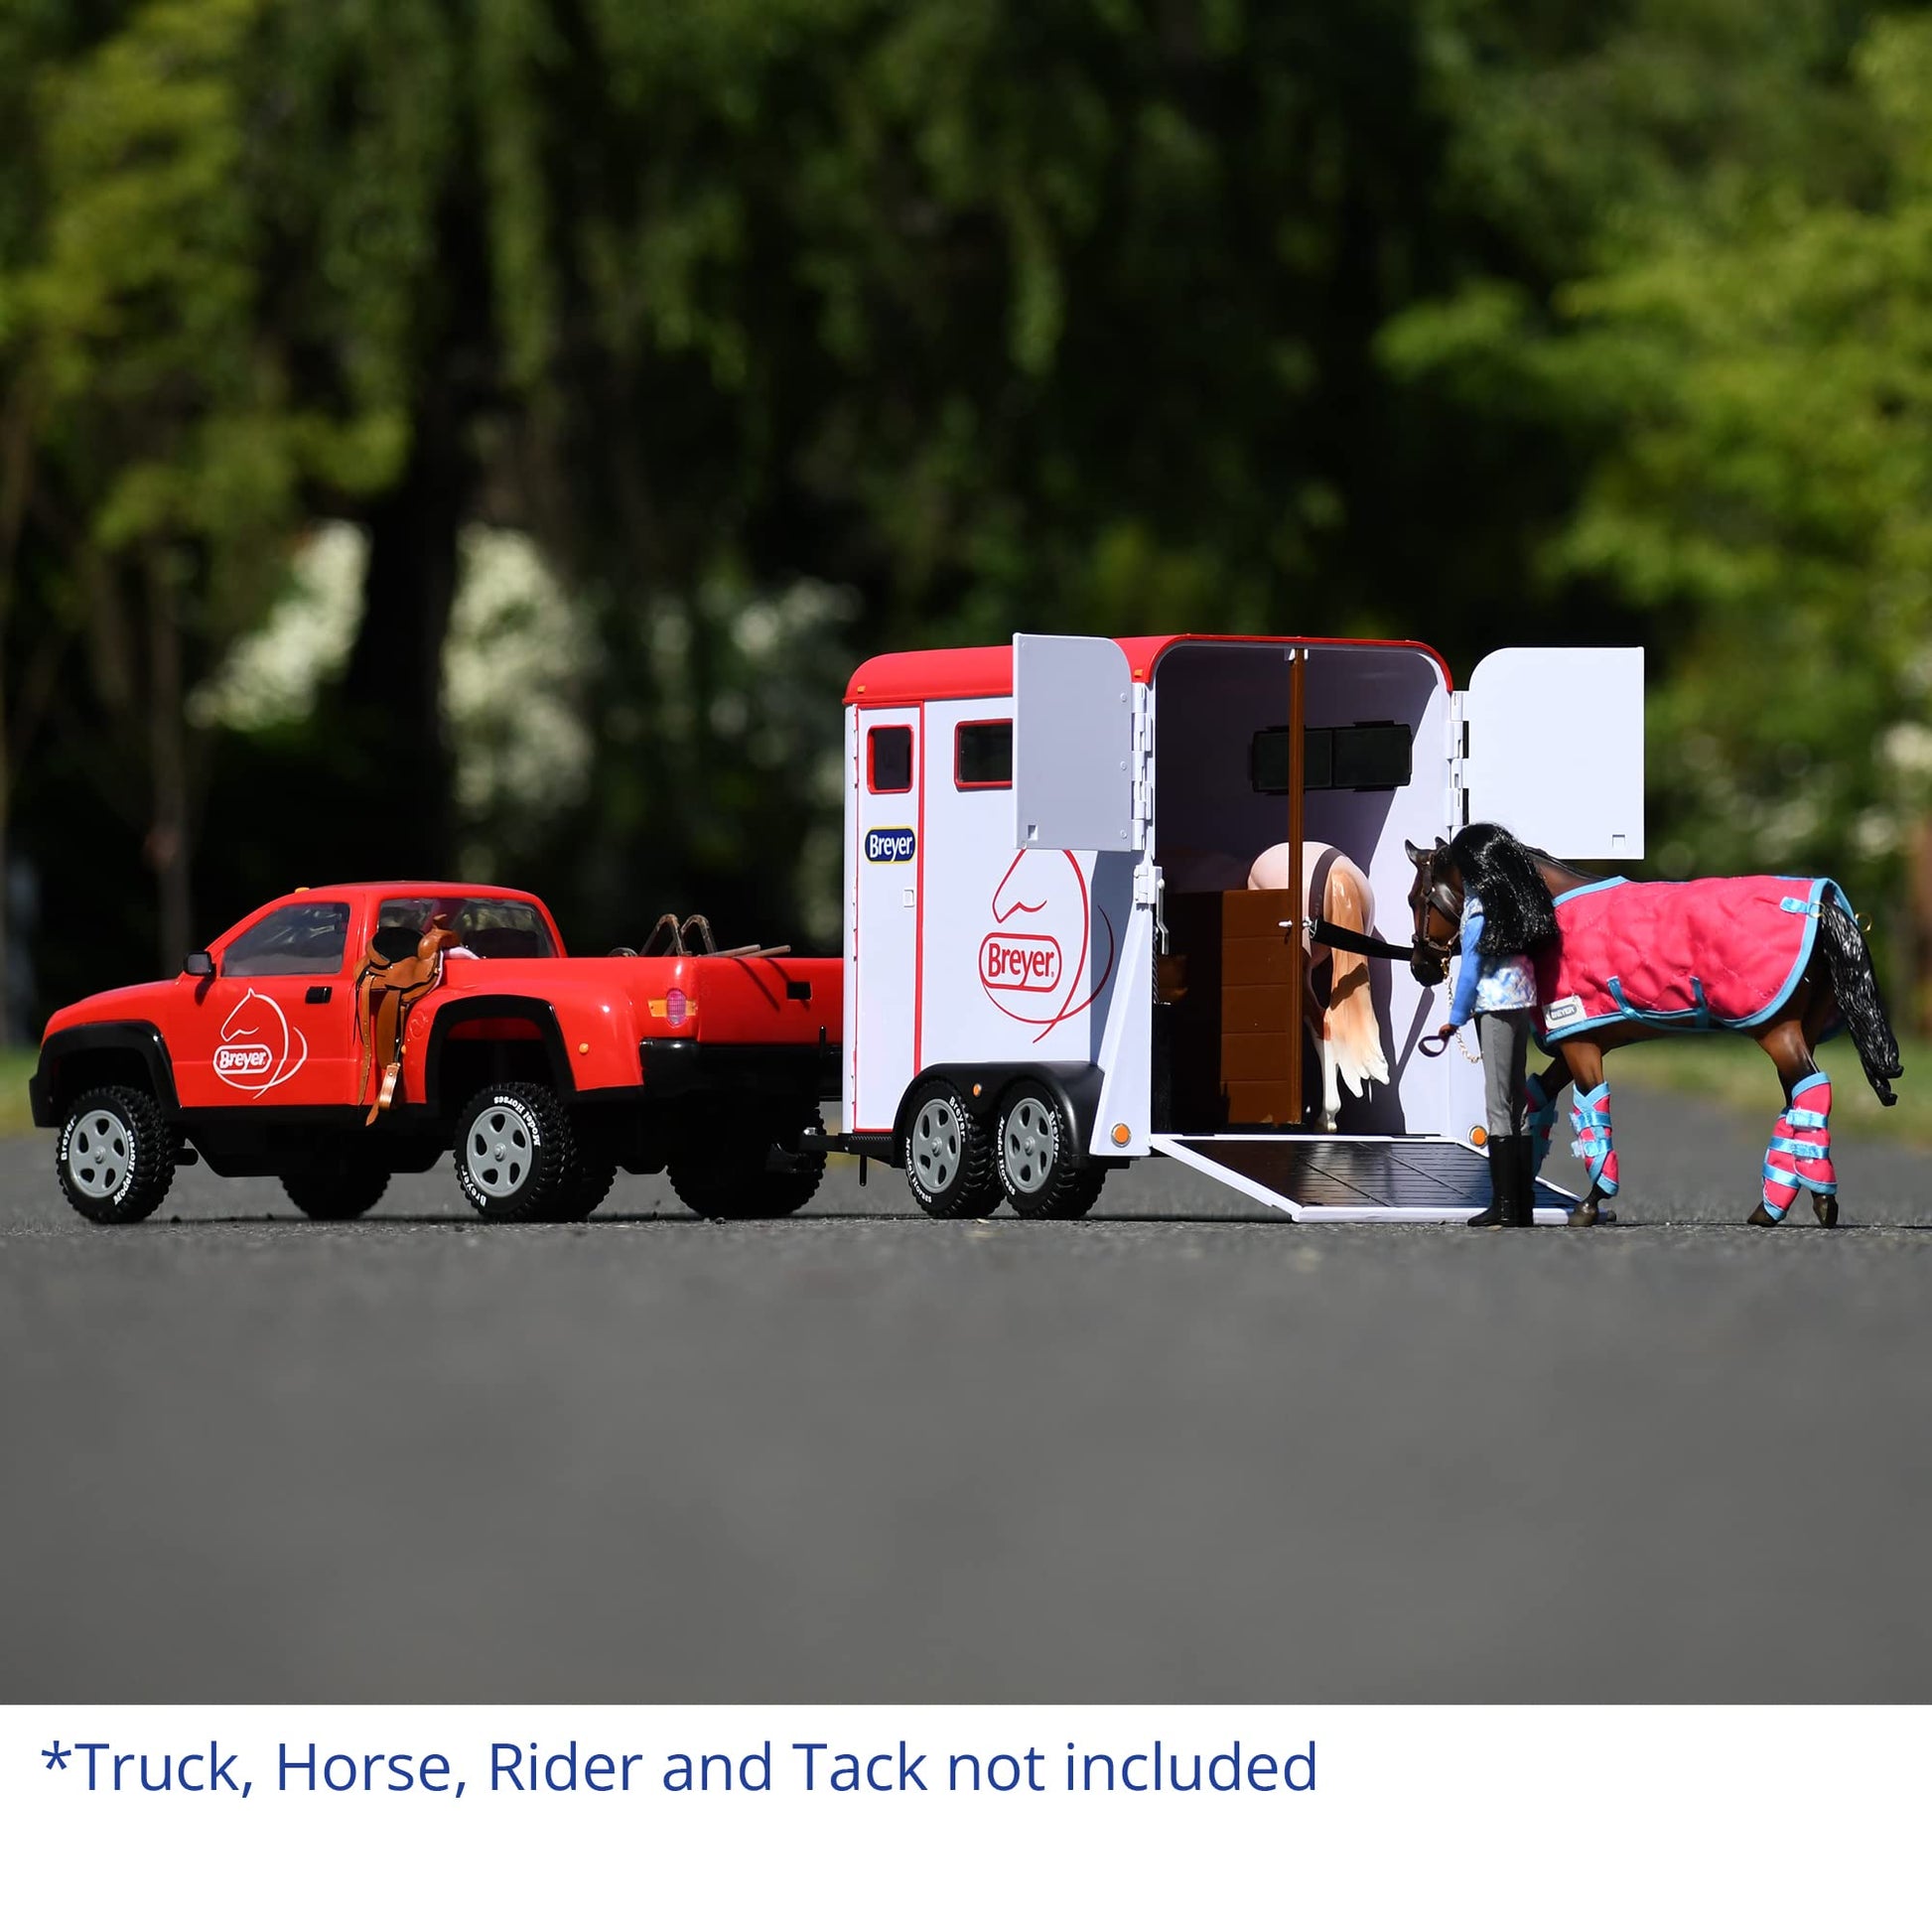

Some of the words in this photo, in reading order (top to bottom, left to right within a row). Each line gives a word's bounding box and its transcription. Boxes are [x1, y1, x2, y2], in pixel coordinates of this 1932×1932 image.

[870, 834, 913, 863] Breyer
[988, 942, 1055, 988] Breyer
[219, 1050, 267, 1071] Breyer
[493, 1096, 525, 1114] Horses
[949, 1096, 966, 1143] Breyer
[61, 1114, 77, 1161] Breyer
[522, 1111, 541, 1147] Model
[1049, 1111, 1059, 1164] Breyer
[112, 1173, 133, 1206] Model
[126, 1130, 136, 1173] Horses
[461, 1165, 487, 1207] Breyer
